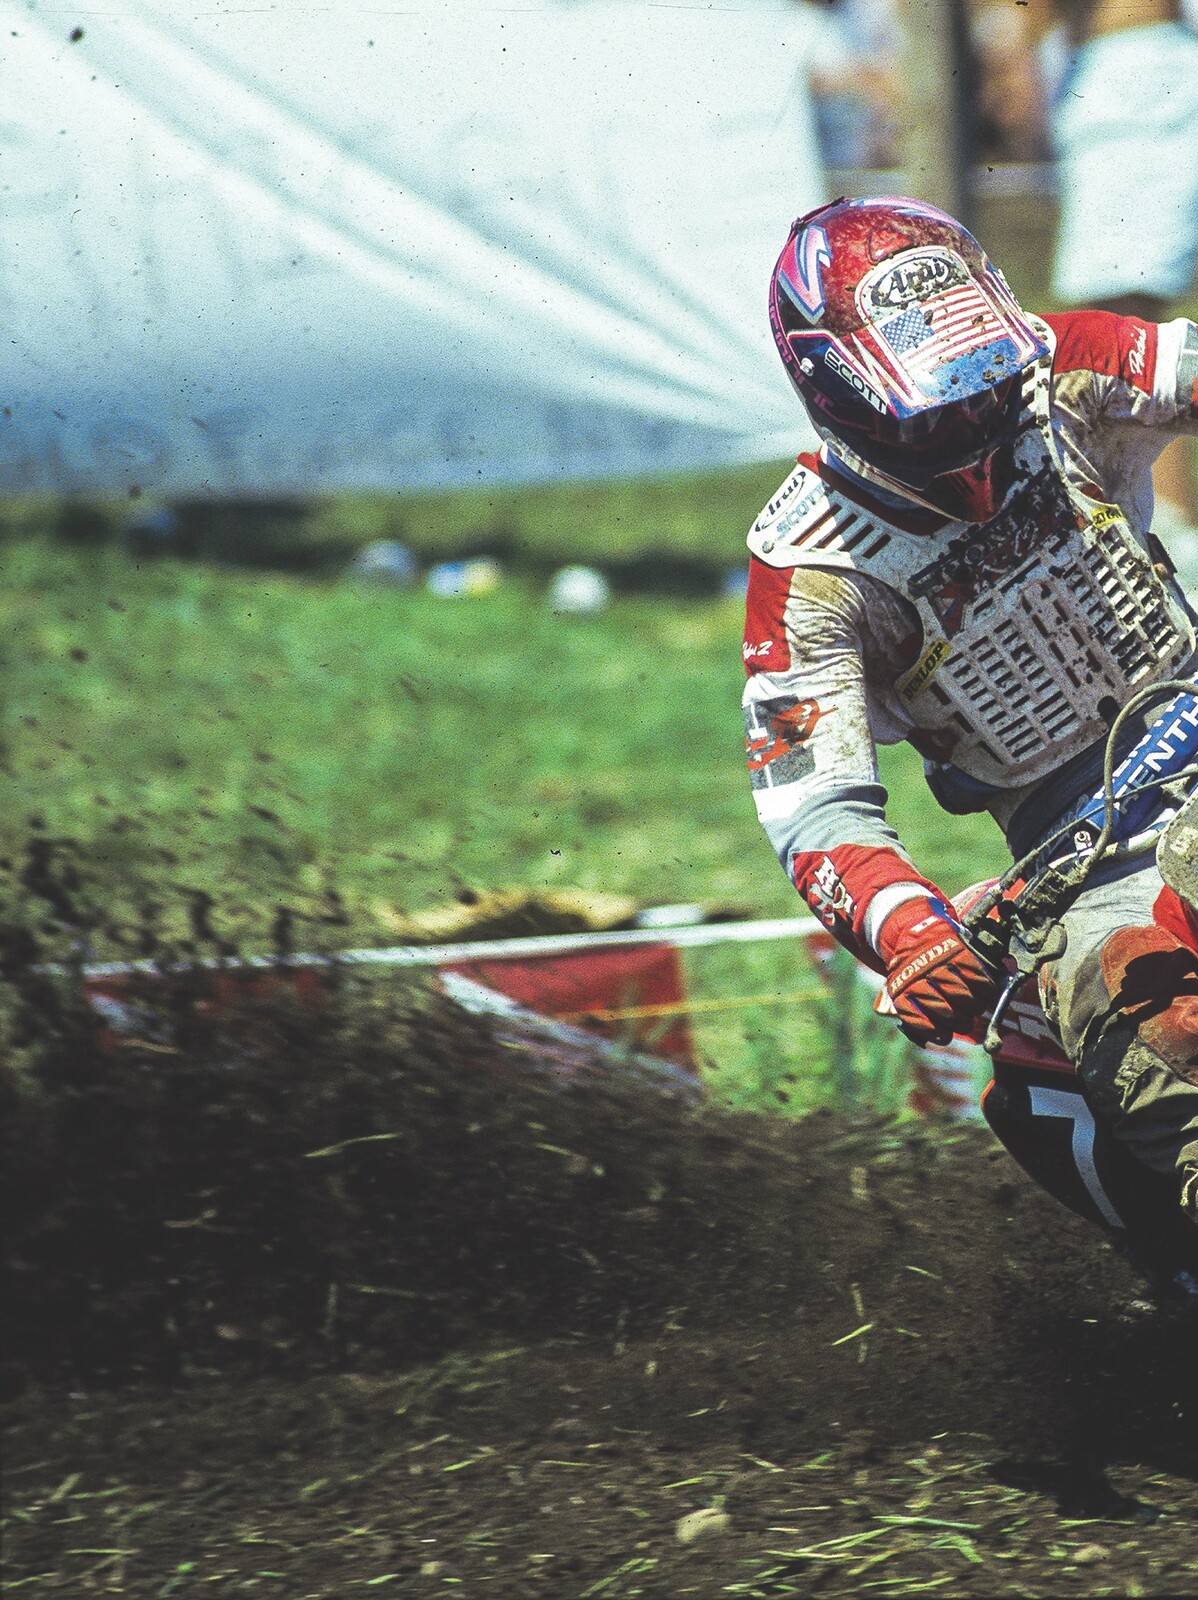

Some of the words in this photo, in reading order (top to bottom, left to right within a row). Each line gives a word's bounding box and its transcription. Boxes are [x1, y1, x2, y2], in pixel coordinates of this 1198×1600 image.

[883, 257, 945, 301] Arai
[824, 346, 888, 415] SCOTT
[903, 641, 944, 701] DUNLOP
[890, 938, 959, 994] HONDA
[1027, 1086, 1127, 1230] 7
